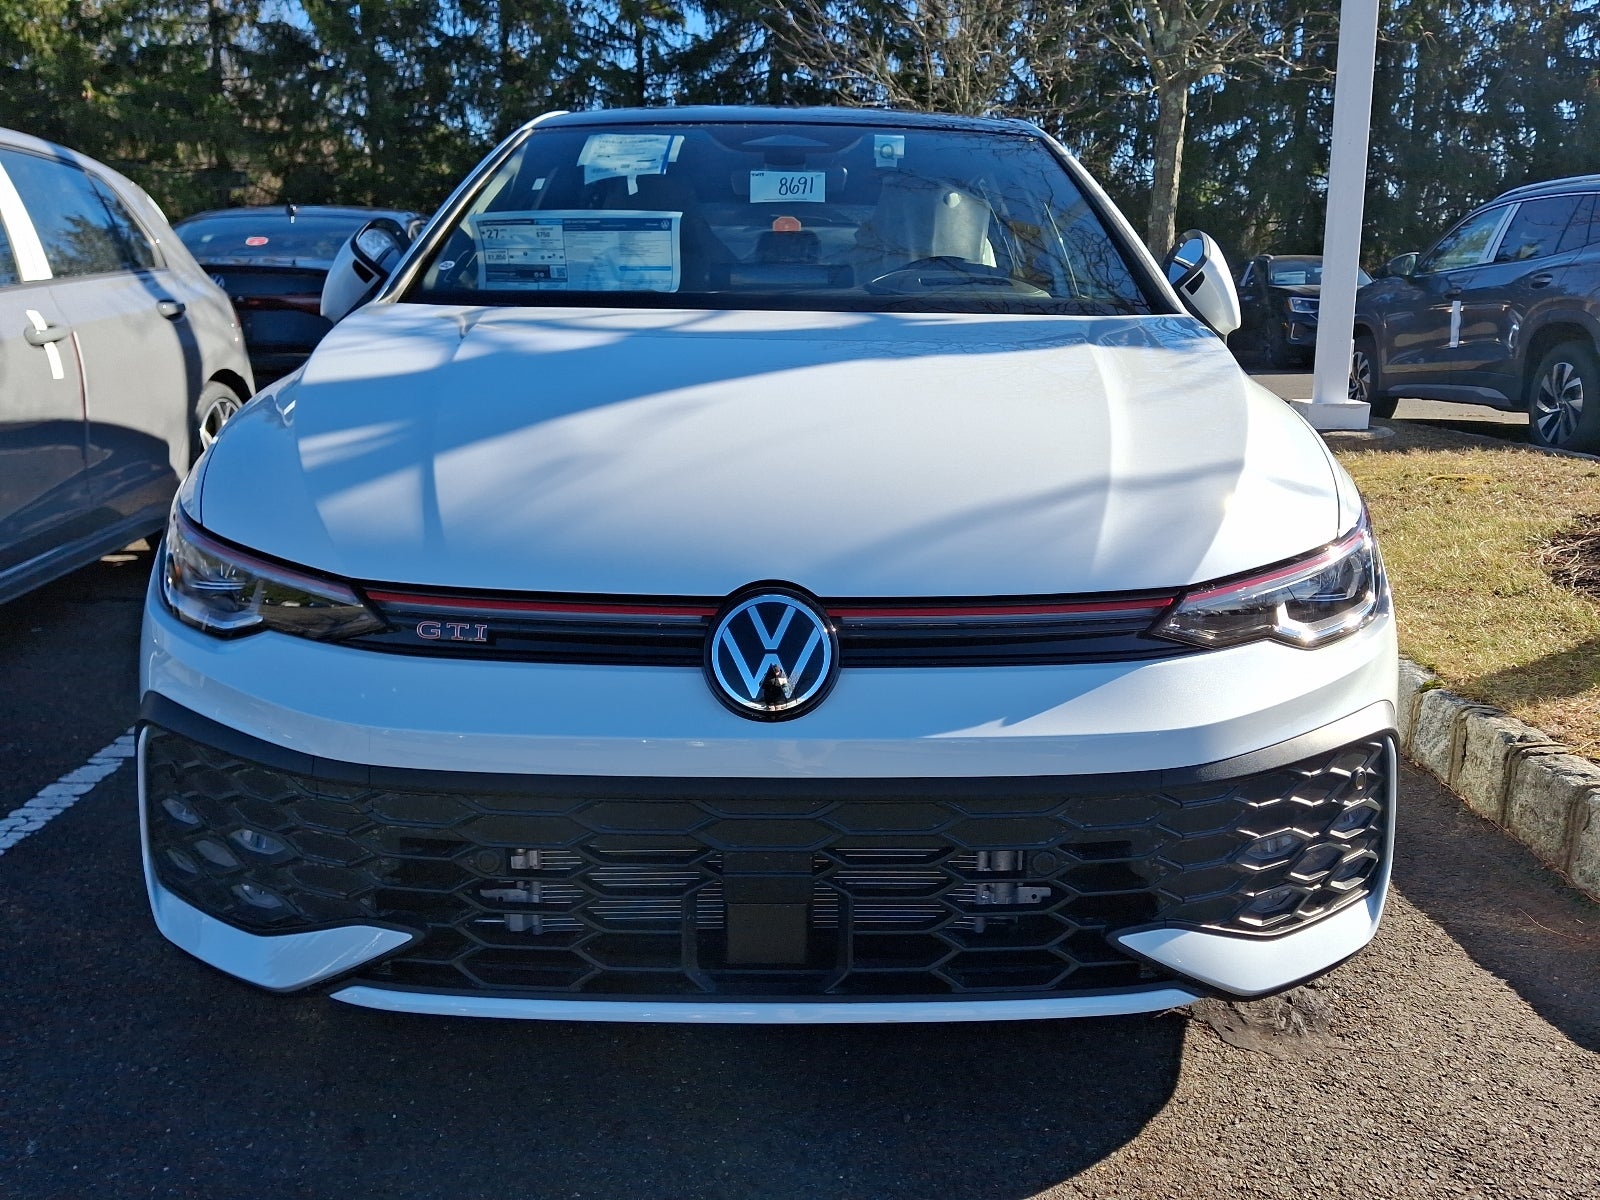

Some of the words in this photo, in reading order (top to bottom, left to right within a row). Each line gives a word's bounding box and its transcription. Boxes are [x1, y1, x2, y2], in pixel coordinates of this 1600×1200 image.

[778, 176, 814, 196] 8691
[486, 228, 499, 239] 27
[416, 620, 488, 642] GTI
[719, 604, 822, 699] VW
